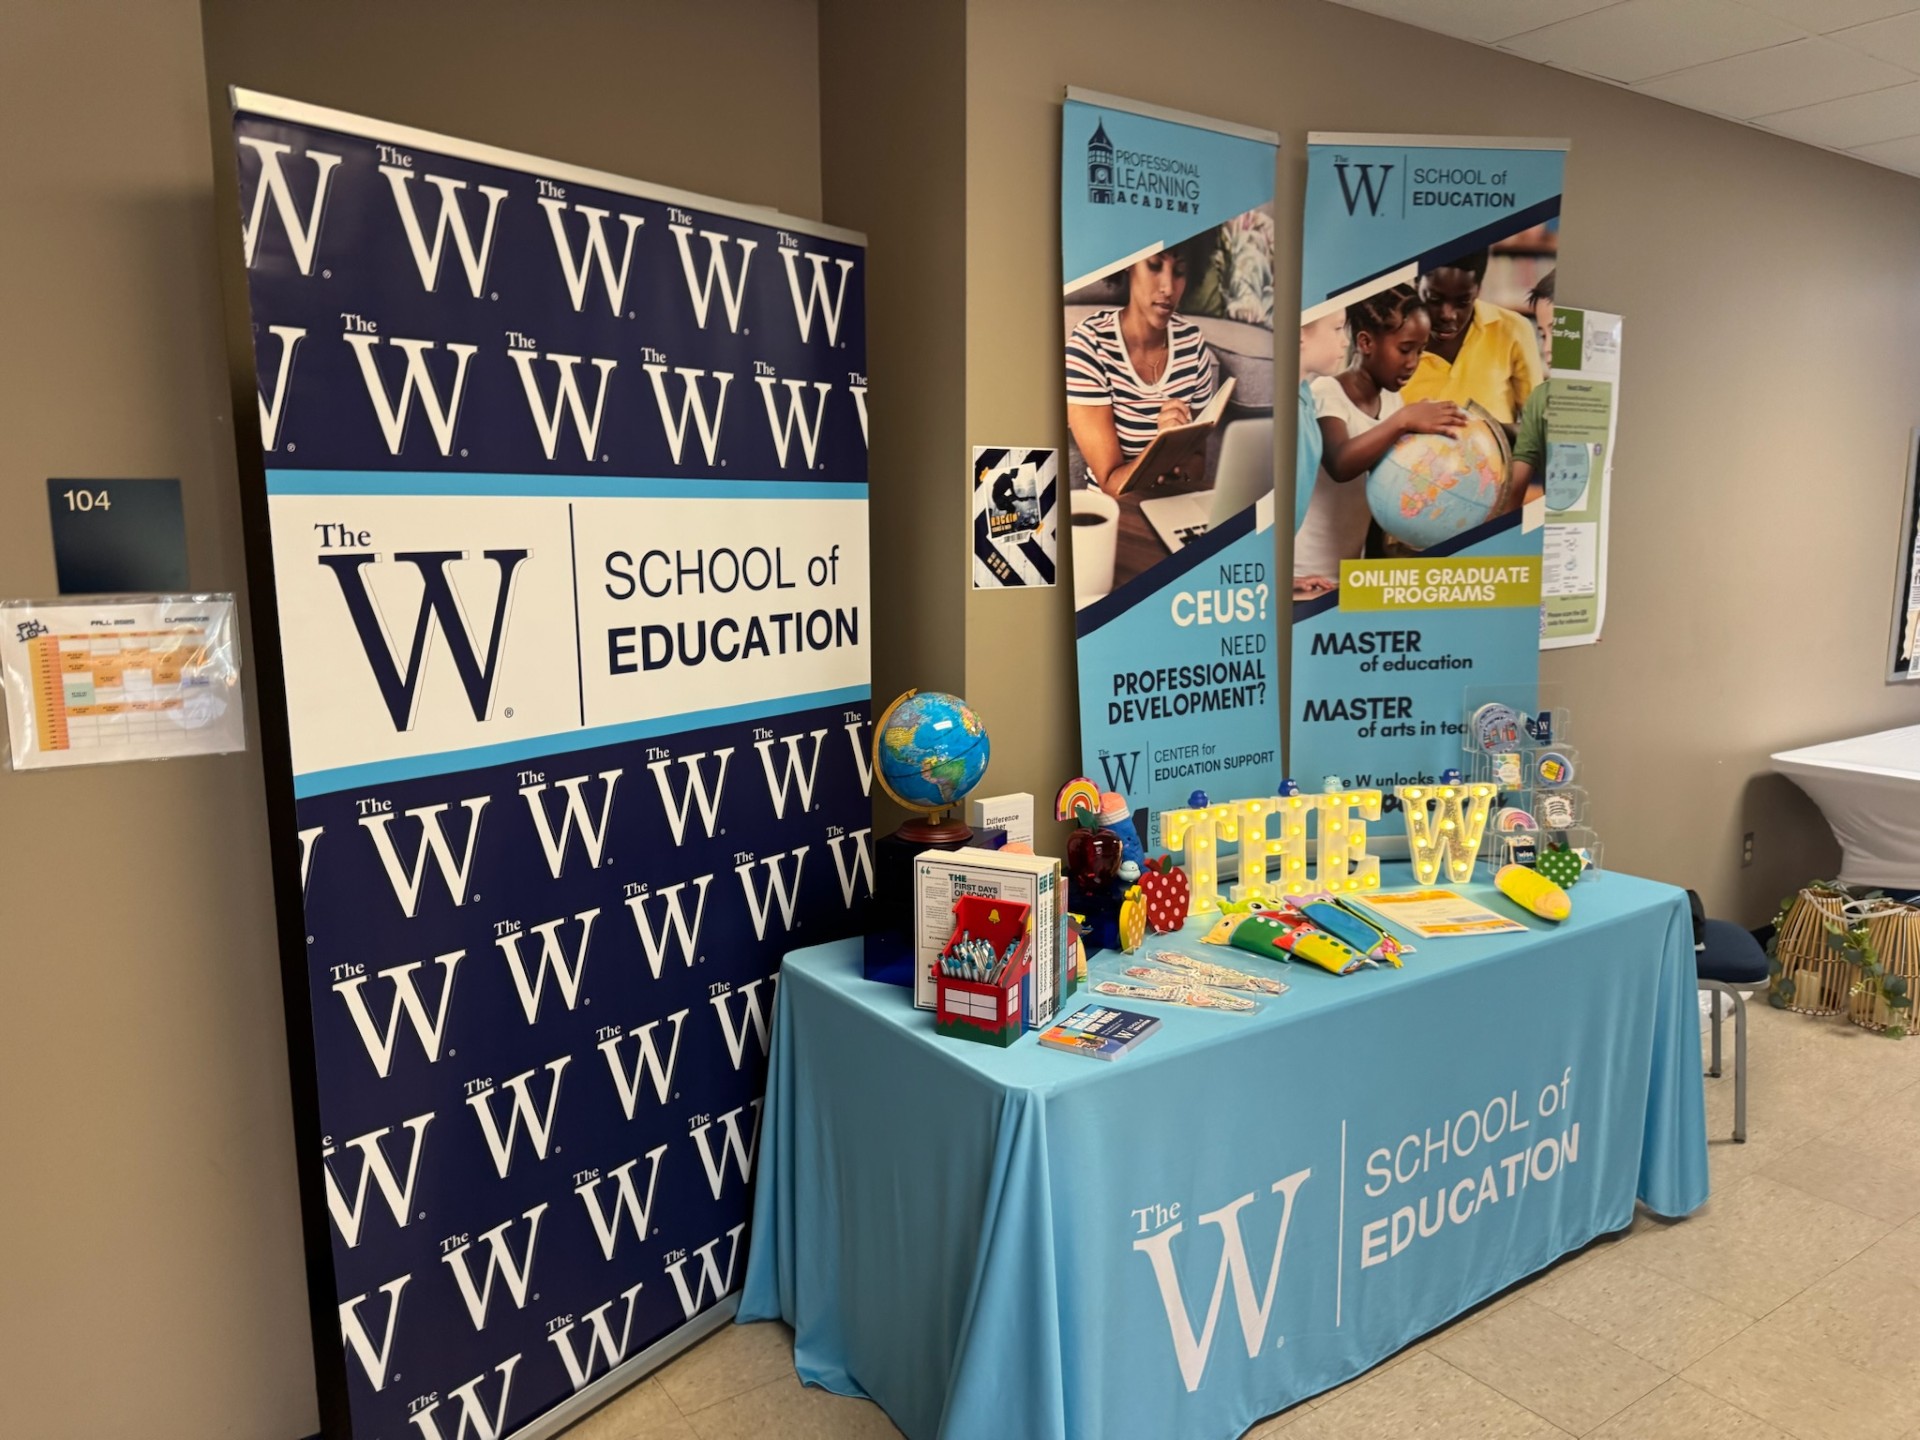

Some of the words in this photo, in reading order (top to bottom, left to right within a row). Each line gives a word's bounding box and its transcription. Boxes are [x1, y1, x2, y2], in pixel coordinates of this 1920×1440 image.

[376, 143, 412, 168] The
[1116, 149, 1201, 179] PROFESSIONAL
[1334, 154, 1348, 163] The
[535, 179, 565, 199] The
[1117, 167, 1200, 200] LEARNING
[1414, 168, 1487, 185] SCHOOL
[1491, 170, 1508, 185] of
[1333, 164, 1394, 217] W
[1412, 191, 1516, 207] EDUCATION
[666, 206, 692, 225] The
[1117, 193, 1200, 215] ACADEMY
[378, 165, 508, 298] W
[777, 230, 798, 248] The
[537, 197, 644, 317] W
[668, 224, 758, 333] W
[778, 246, 854, 347] W
[340, 312, 378, 334] The
[505, 330, 536, 350] The
[640, 346, 667, 365] The
[754, 359, 775, 376] The
[848, 371, 868, 386] The
[343, 332, 478, 456] W
[507, 348, 617, 461] W
[642, 362, 734, 466] W
[754, 375, 832, 469] W
[63, 490, 111, 511] 104
[314, 522, 371, 548] The
[604, 545, 796, 600] SCHOOL
[807, 544, 840, 587] of
[1220, 562, 1265, 585] NEED
[1348, 568, 1419, 588] ONLINE
[1425, 566, 1530, 585] GRADUATE
[1171, 583, 1269, 627] CEUS?
[1382, 585, 1496, 604] PROGRAMS
[317, 549, 534, 732] W
[606, 606, 859, 675] EDUCATION
[1221, 633, 1267, 657] NEED
[1311, 630, 1421, 655] MASTER
[1360, 655, 1378, 672] of
[1383, 655, 1472, 671] education
[1113, 658, 1266, 696] PROFESSIONAL
[1108, 681, 1266, 725] DEVELOPMENT?
[1302, 696, 1412, 722] MASTER
[844, 710, 861, 722] The
[753, 727, 773, 740] The
[1357, 721, 1376, 738] of
[1381, 721, 1415, 736] arts
[1420, 721, 1436, 735] in
[646, 746, 670, 760] The
[1154, 745, 1200, 764] CENTER
[1202, 743, 1216, 755] for
[517, 770, 545, 785] The
[753, 729, 828, 820] W
[1098, 751, 1141, 796] W
[1154, 758, 1221, 782] EDUCATION
[1224, 750, 1275, 770] SUPPORT
[1356, 775, 1371, 787] W
[1376, 772, 1434, 787] unlocks
[356, 796, 391, 815] The
[646, 747, 735, 846] W
[519, 769, 623, 879] W
[826, 824, 844, 838] The
[986, 814, 1019, 826] Difference
[358, 795, 492, 918] W
[734, 850, 754, 865] The
[1160, 789, 1382, 917] THE
[1395, 782, 1498, 885] W
[623, 880, 648, 896] The
[948, 874, 967, 882] THE
[954, 883, 976, 891] FIRST
[978, 885, 998, 894] DAYS
[734, 846, 809, 941] W
[494, 918, 521, 936] The
[624, 873, 713, 980] W
[330, 960, 364, 980] The
[495, 908, 601, 1025] W
[709, 978, 730, 995] The
[332, 949, 466, 1079] W
[596, 1022, 621, 1041] The
[597, 1008, 690, 1120] W
[463, 1075, 492, 1097] The
[465, 1055, 572, 1179] W
[688, 1111, 710, 1129] The
[1364, 1090, 1530, 1197] SCHOOL
[1538, 1067, 1572, 1117] of
[689, 1097, 764, 1201] W
[323, 1112, 436, 1249] W
[572, 1166, 600, 1185] The
[574, 1144, 668, 1261] W
[1360, 1122, 1580, 1270] EDUCATION
[1131, 1202, 1181, 1234] The
[440, 1230, 469, 1253] The
[441, 1202, 549, 1332] W
[663, 1247, 686, 1266] The
[665, 1222, 746, 1318] W
[1133, 1168, 1311, 1392] W
[546, 1311, 573, 1333] The
[547, 1282, 643, 1392] W
[408, 1391, 438, 1415] The
